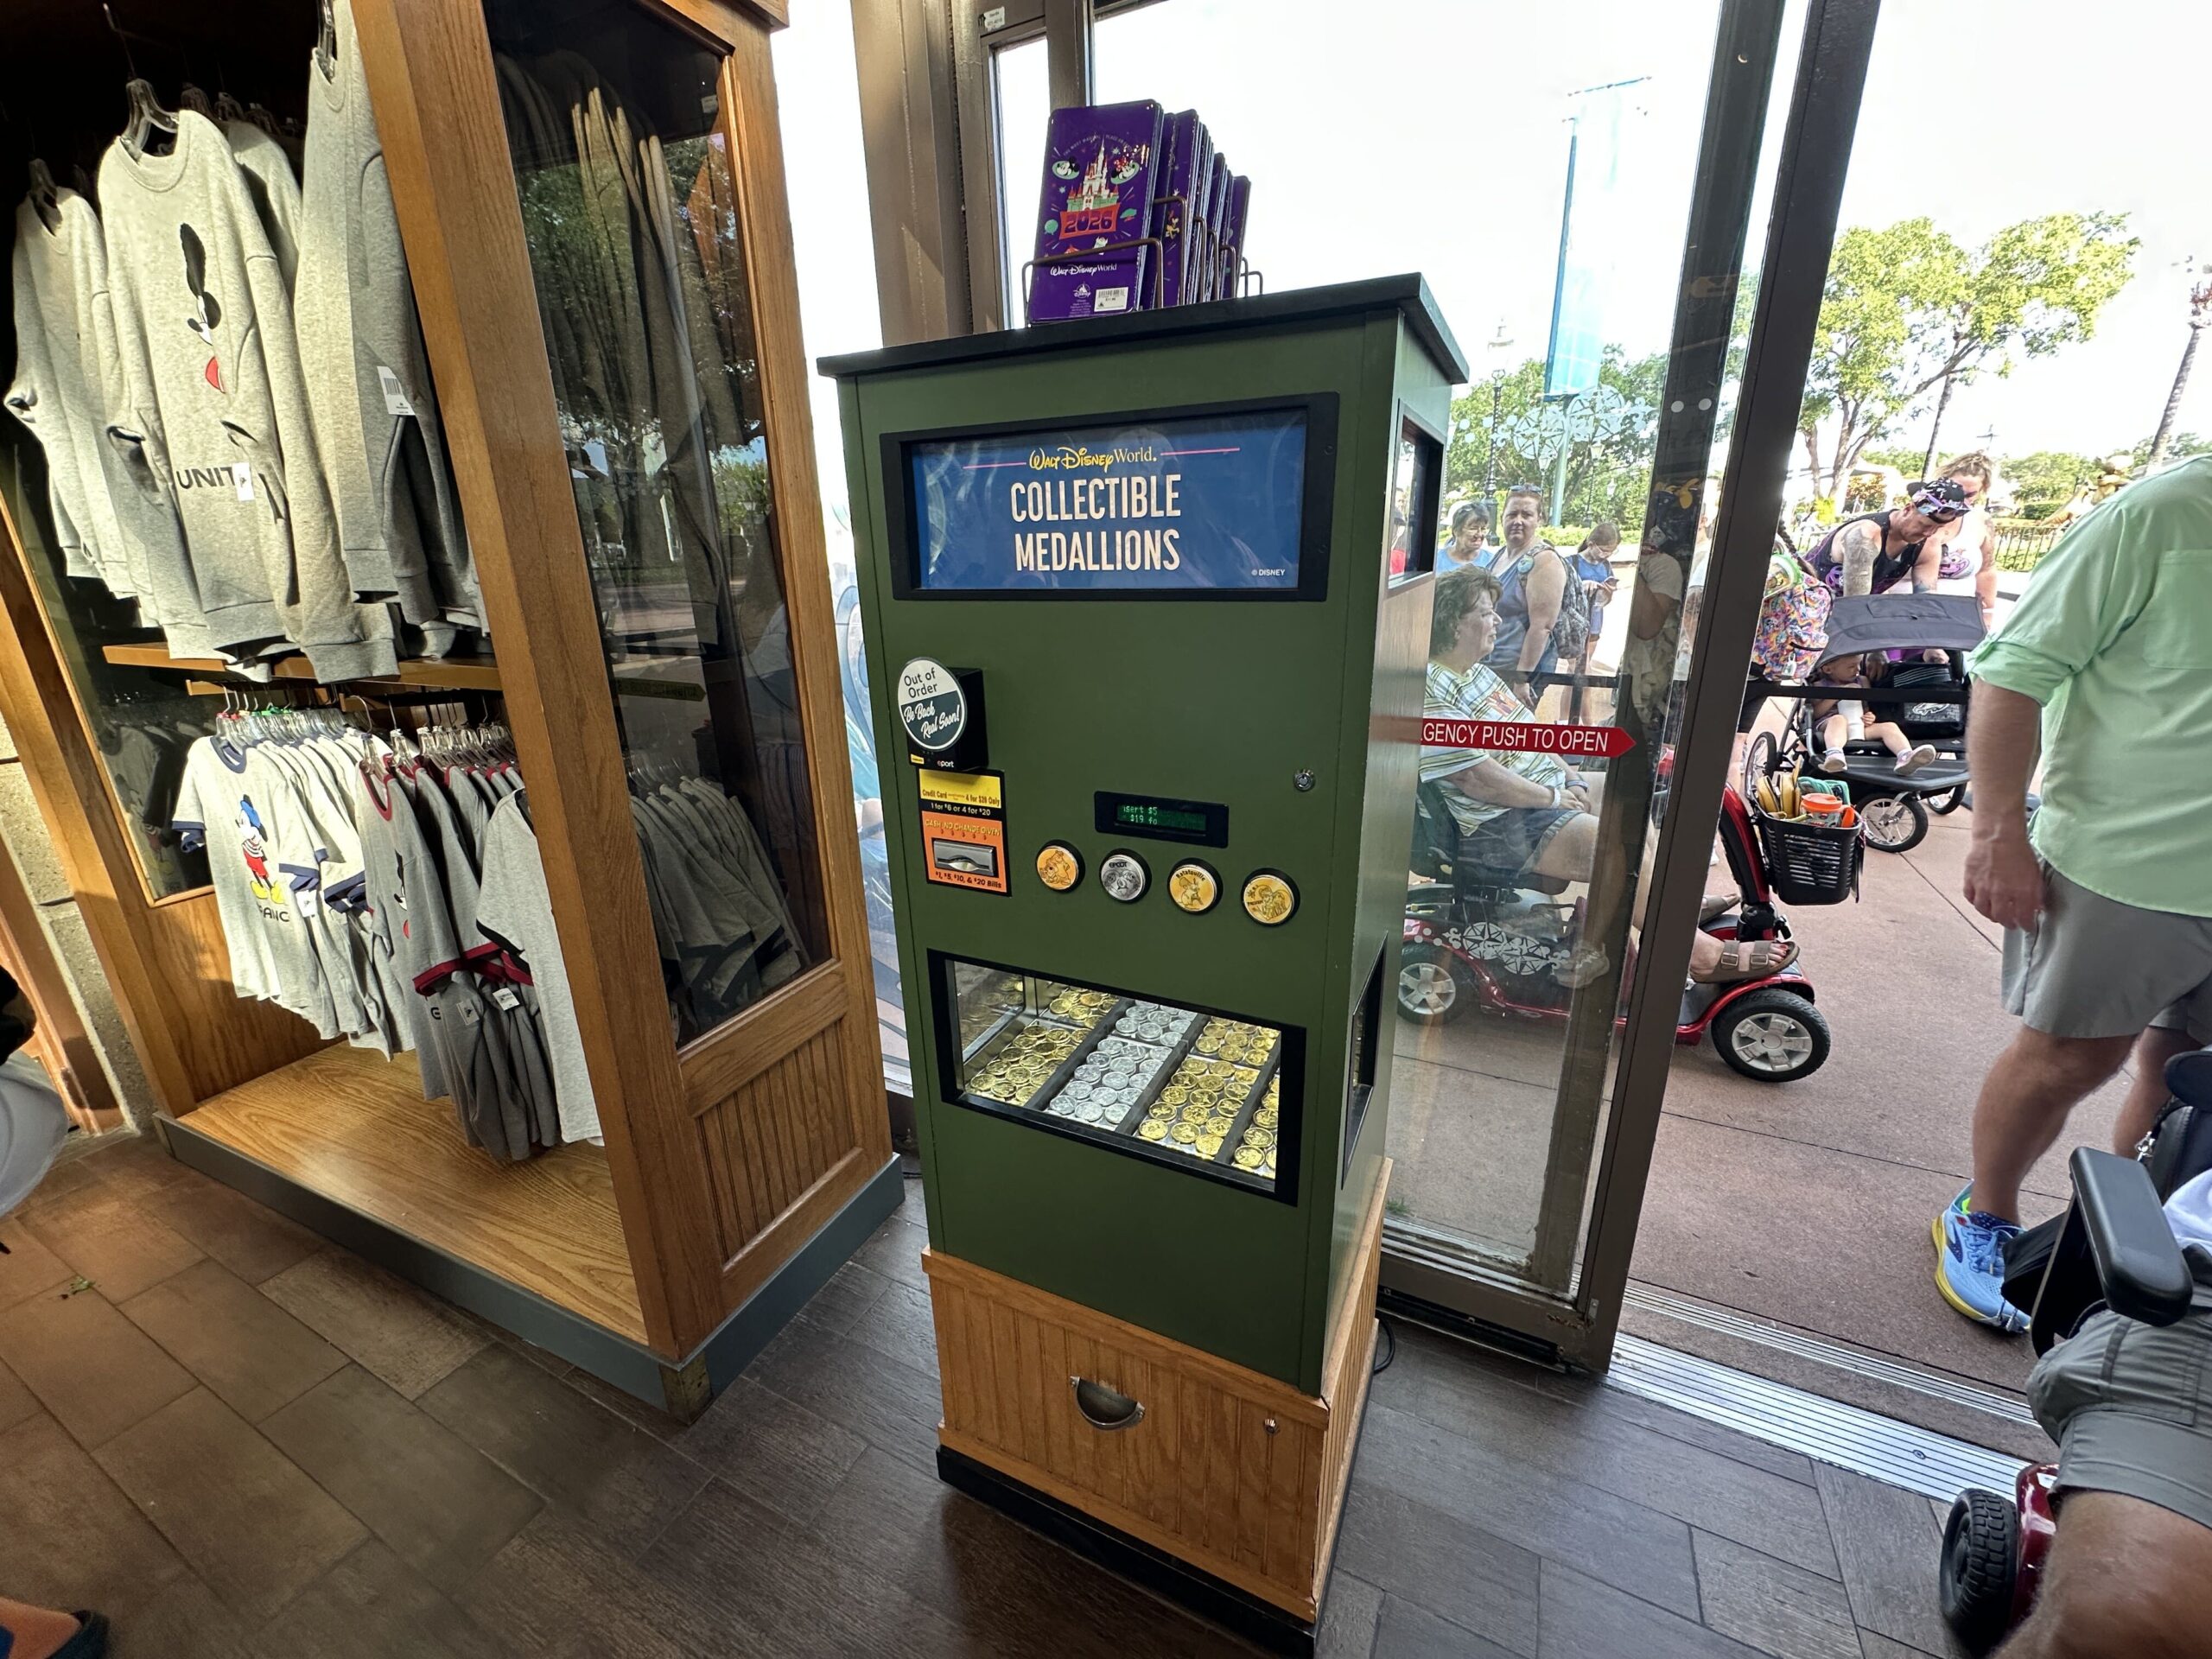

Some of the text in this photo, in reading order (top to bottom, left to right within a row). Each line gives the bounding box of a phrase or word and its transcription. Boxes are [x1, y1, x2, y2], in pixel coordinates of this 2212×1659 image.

[1065, 210, 1113, 233] 2026
[1097, 264, 1117, 272] World
[1010, 474, 1182, 523] COLLECTIBLE
[1014, 529, 1181, 572] MEDALLIONS
[904, 667, 937, 687] Out of
[908, 683, 938, 698] Order
[904, 701, 936, 723] Be Back
[920, 704, 961, 739] Real Soon!
[1421, 722, 1609, 753] GENCY PUSH TO OPEN
[968, 805, 978, 814] for
[979, 808, 991, 817] $20
